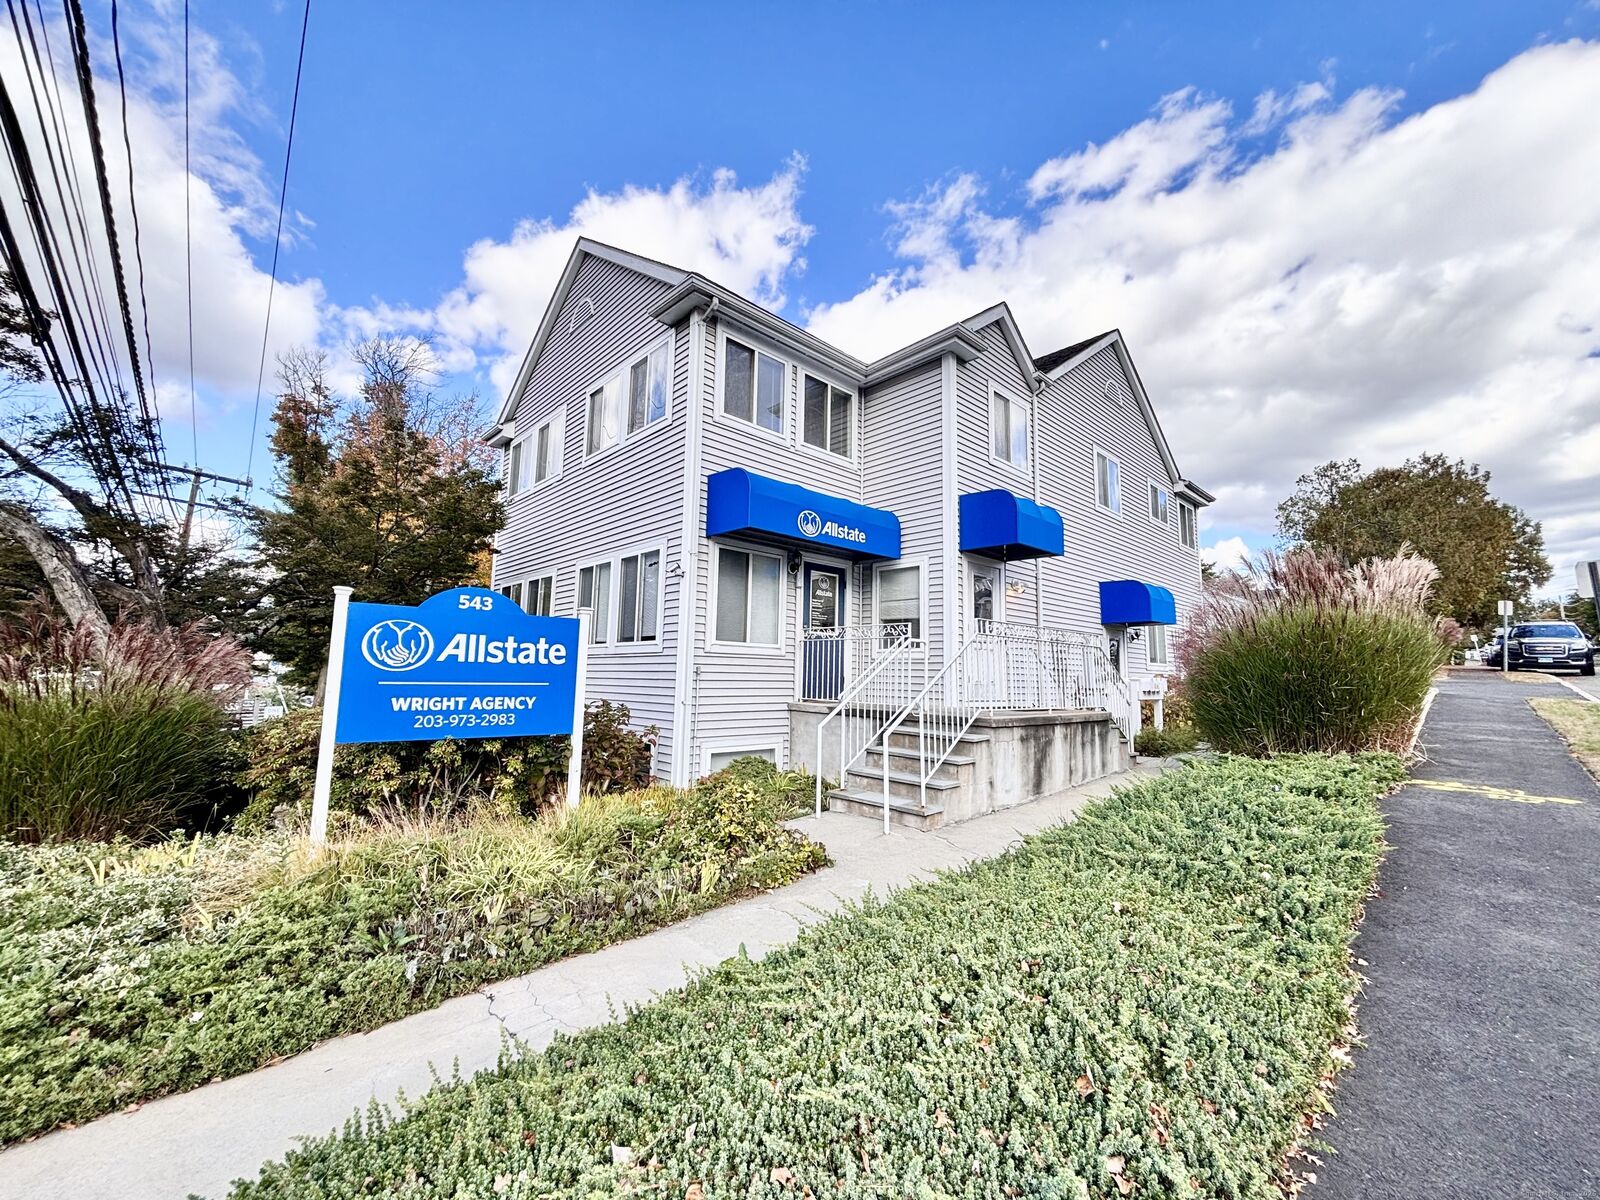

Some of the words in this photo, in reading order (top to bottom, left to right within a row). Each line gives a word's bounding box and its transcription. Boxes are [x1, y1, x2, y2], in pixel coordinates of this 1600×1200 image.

[821, 521, 866, 543] Allstate
[458, 594, 493, 611] 543
[436, 633, 567, 665] Allstate
[391, 696, 467, 712] WRIGHT
[469, 696, 537, 710] AGENCY
[413, 713, 516, 728] 203-973-2983
